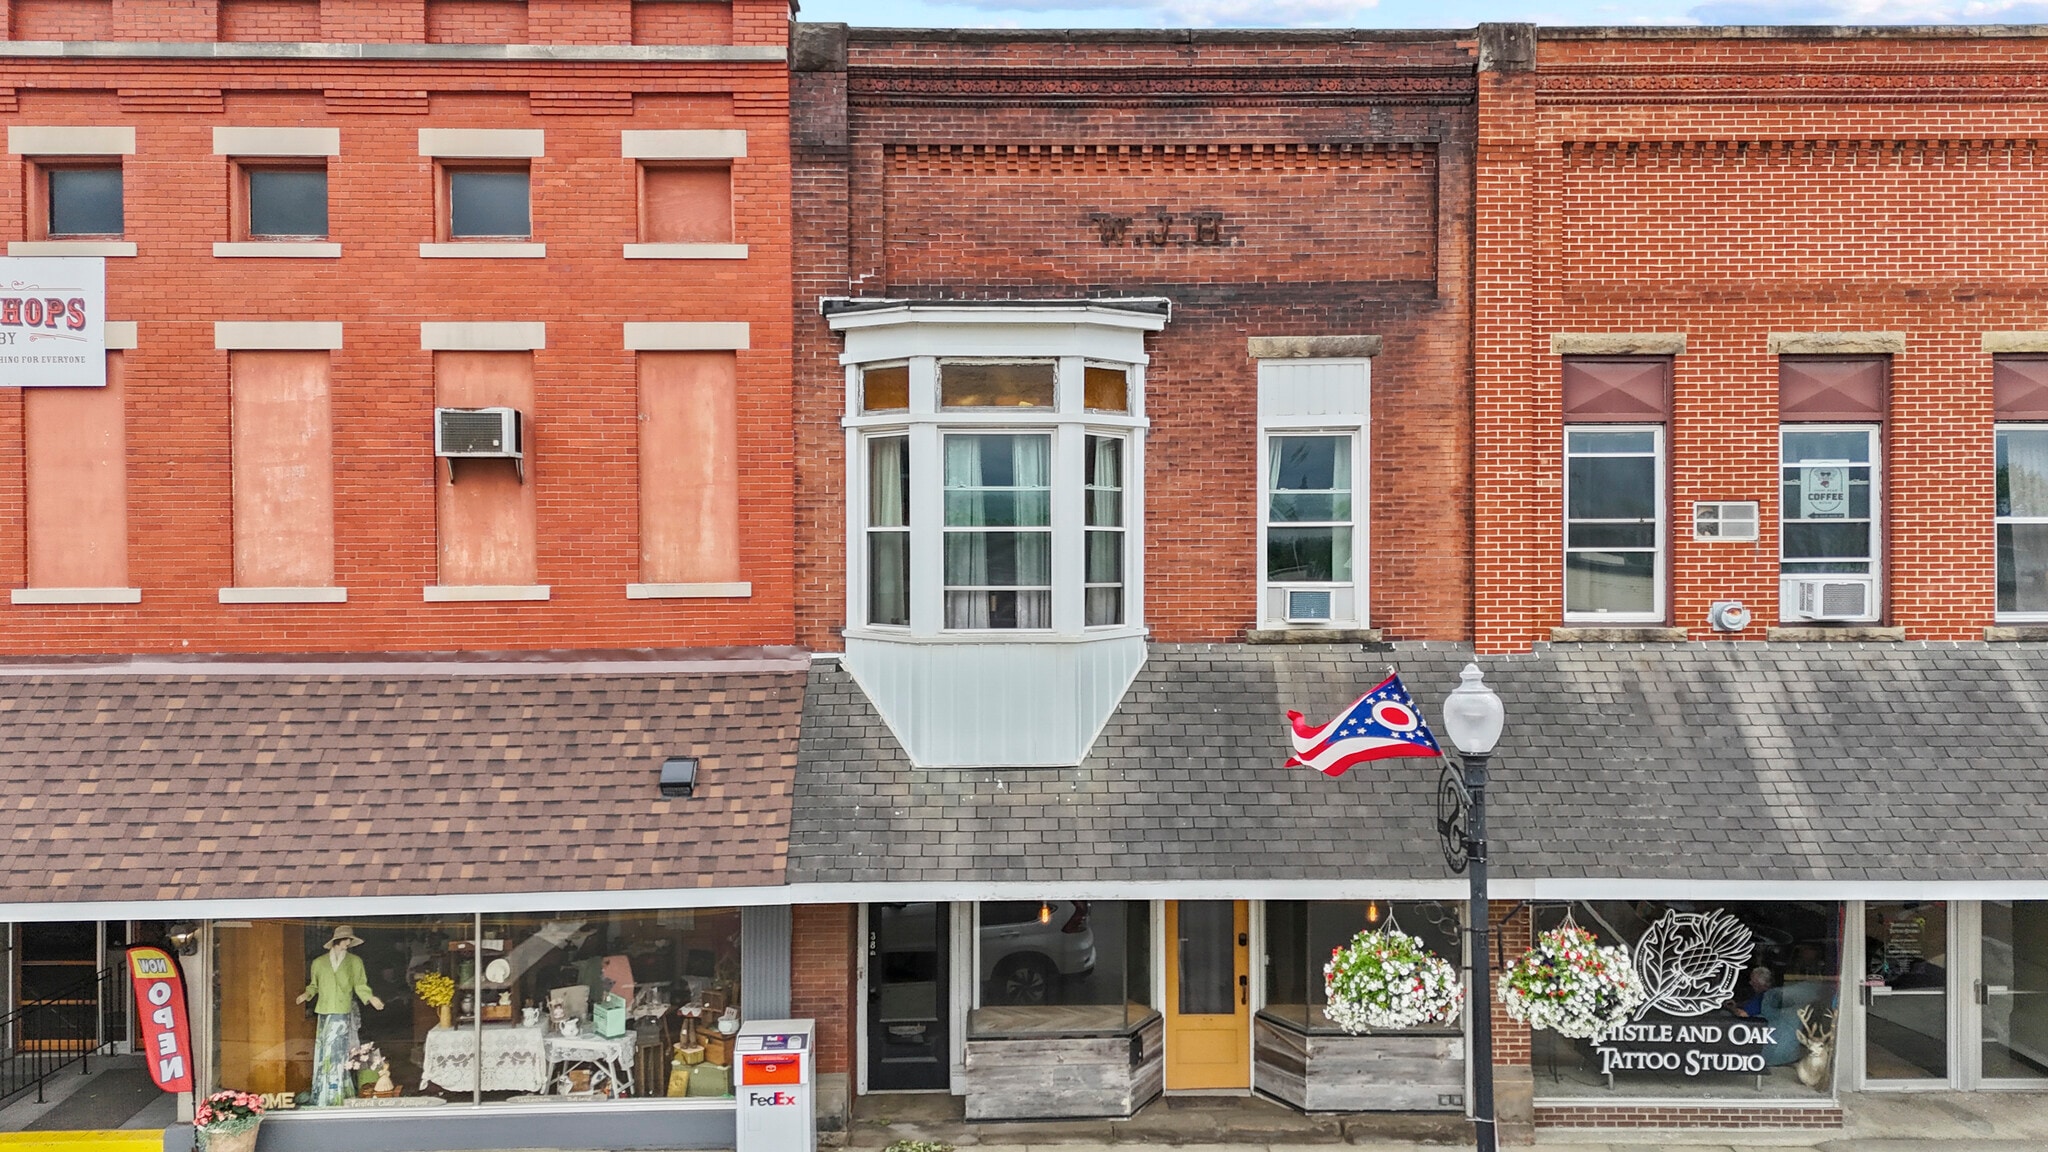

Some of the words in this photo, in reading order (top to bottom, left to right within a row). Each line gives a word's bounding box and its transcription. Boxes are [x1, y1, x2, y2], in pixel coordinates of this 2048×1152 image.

[0, 297, 87, 332] HOPS
[21, 355, 39, 364] FOR
[41, 355, 86, 364] EVERYONE
[1808, 493, 1844, 501] COFFEE
[1675, 1025, 1723, 1044] AND
[1596, 1047, 1681, 1075] TATTOO
[1684, 1050, 1767, 1077] STUDIO
[750, 1091, 796, 1107] FedEx
